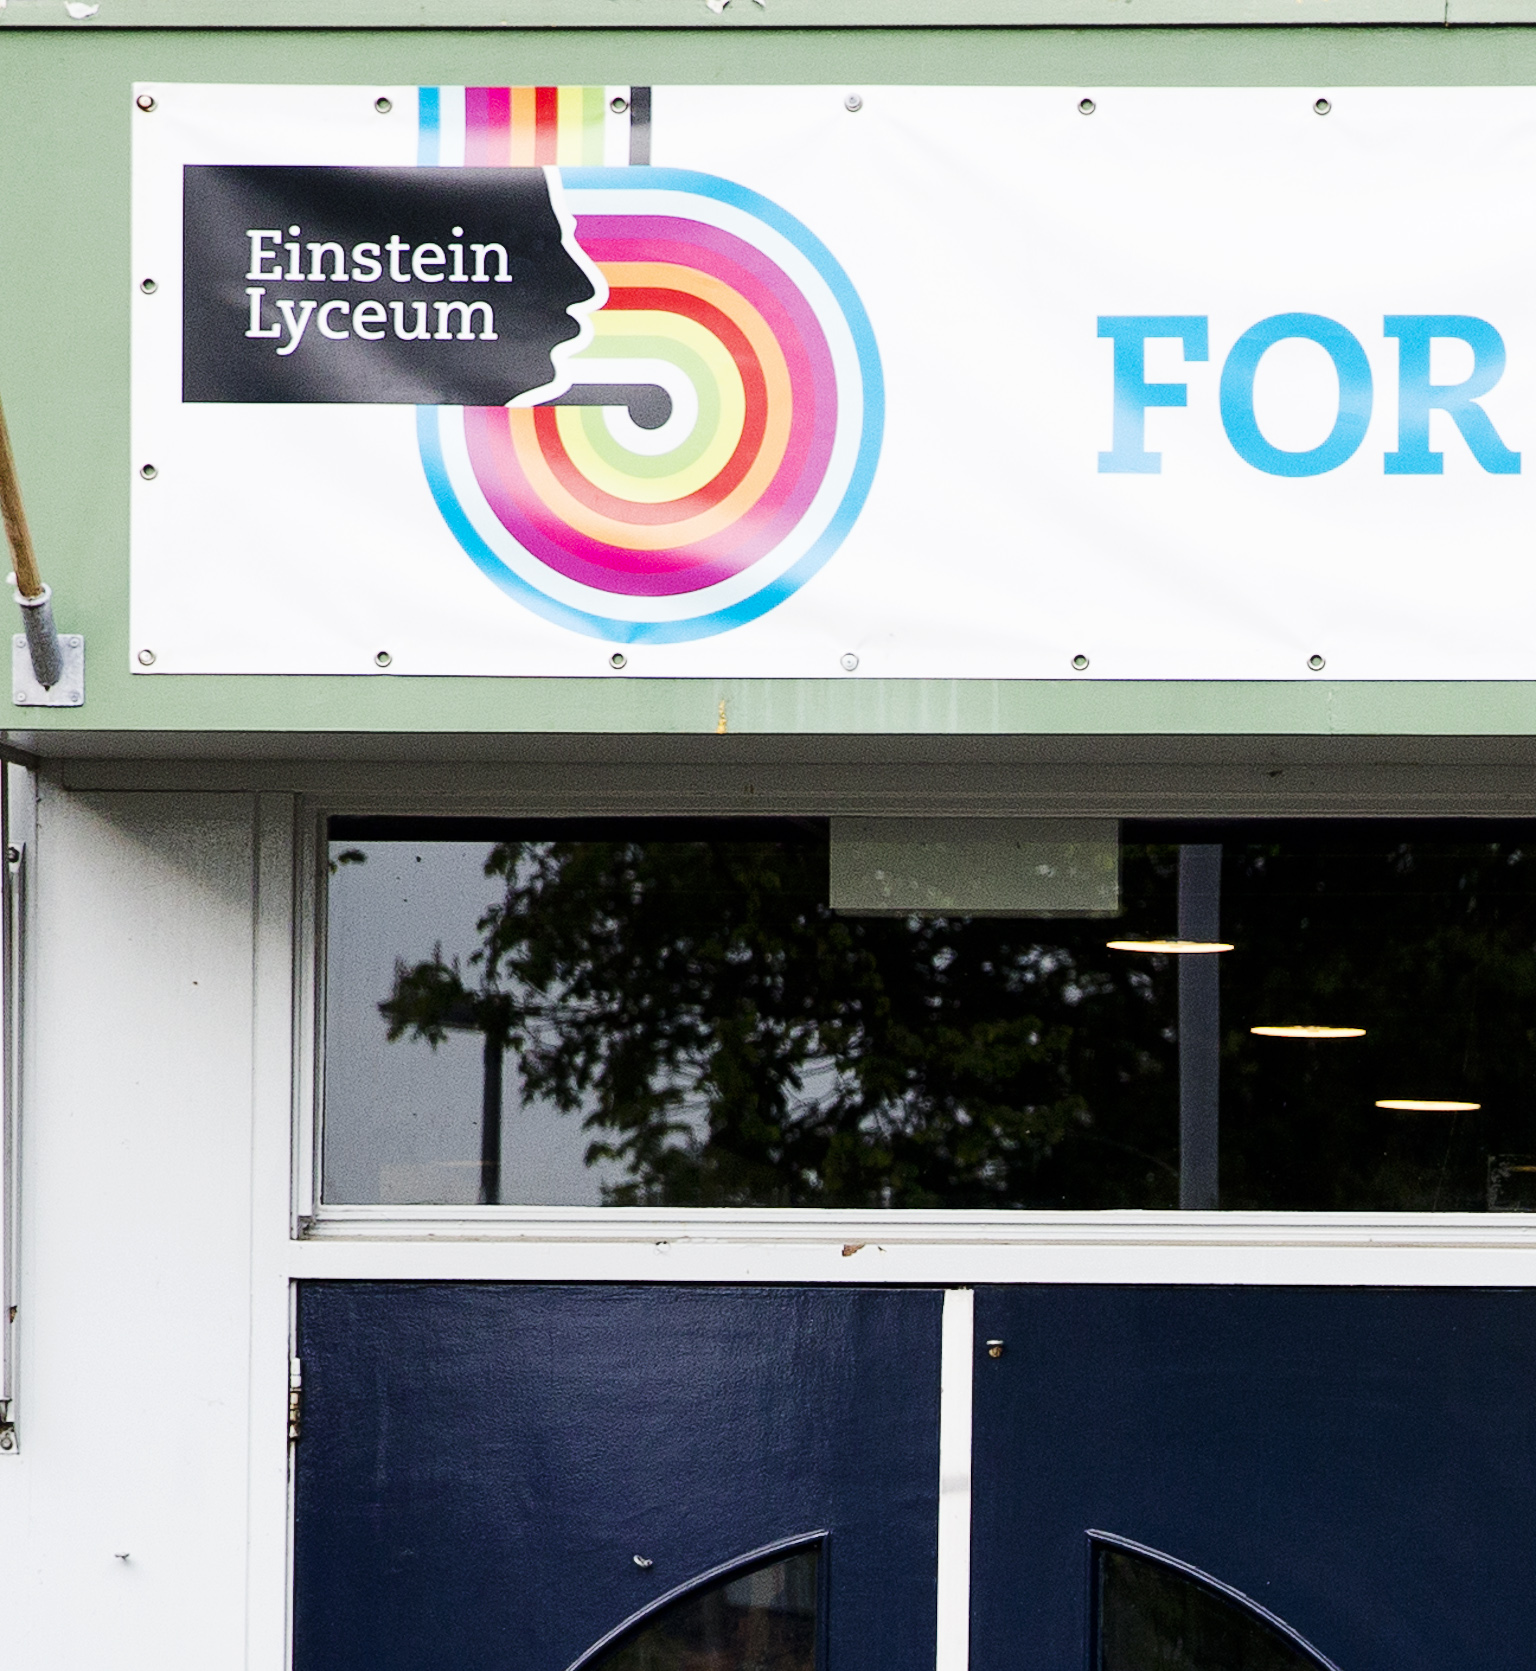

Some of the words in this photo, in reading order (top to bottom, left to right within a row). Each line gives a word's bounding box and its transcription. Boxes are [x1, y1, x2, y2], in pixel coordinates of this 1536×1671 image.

[245, 225, 513, 283] Einstein
[245, 286, 500, 356] Lyceum
[1096, 311, 1522, 478] FOR
